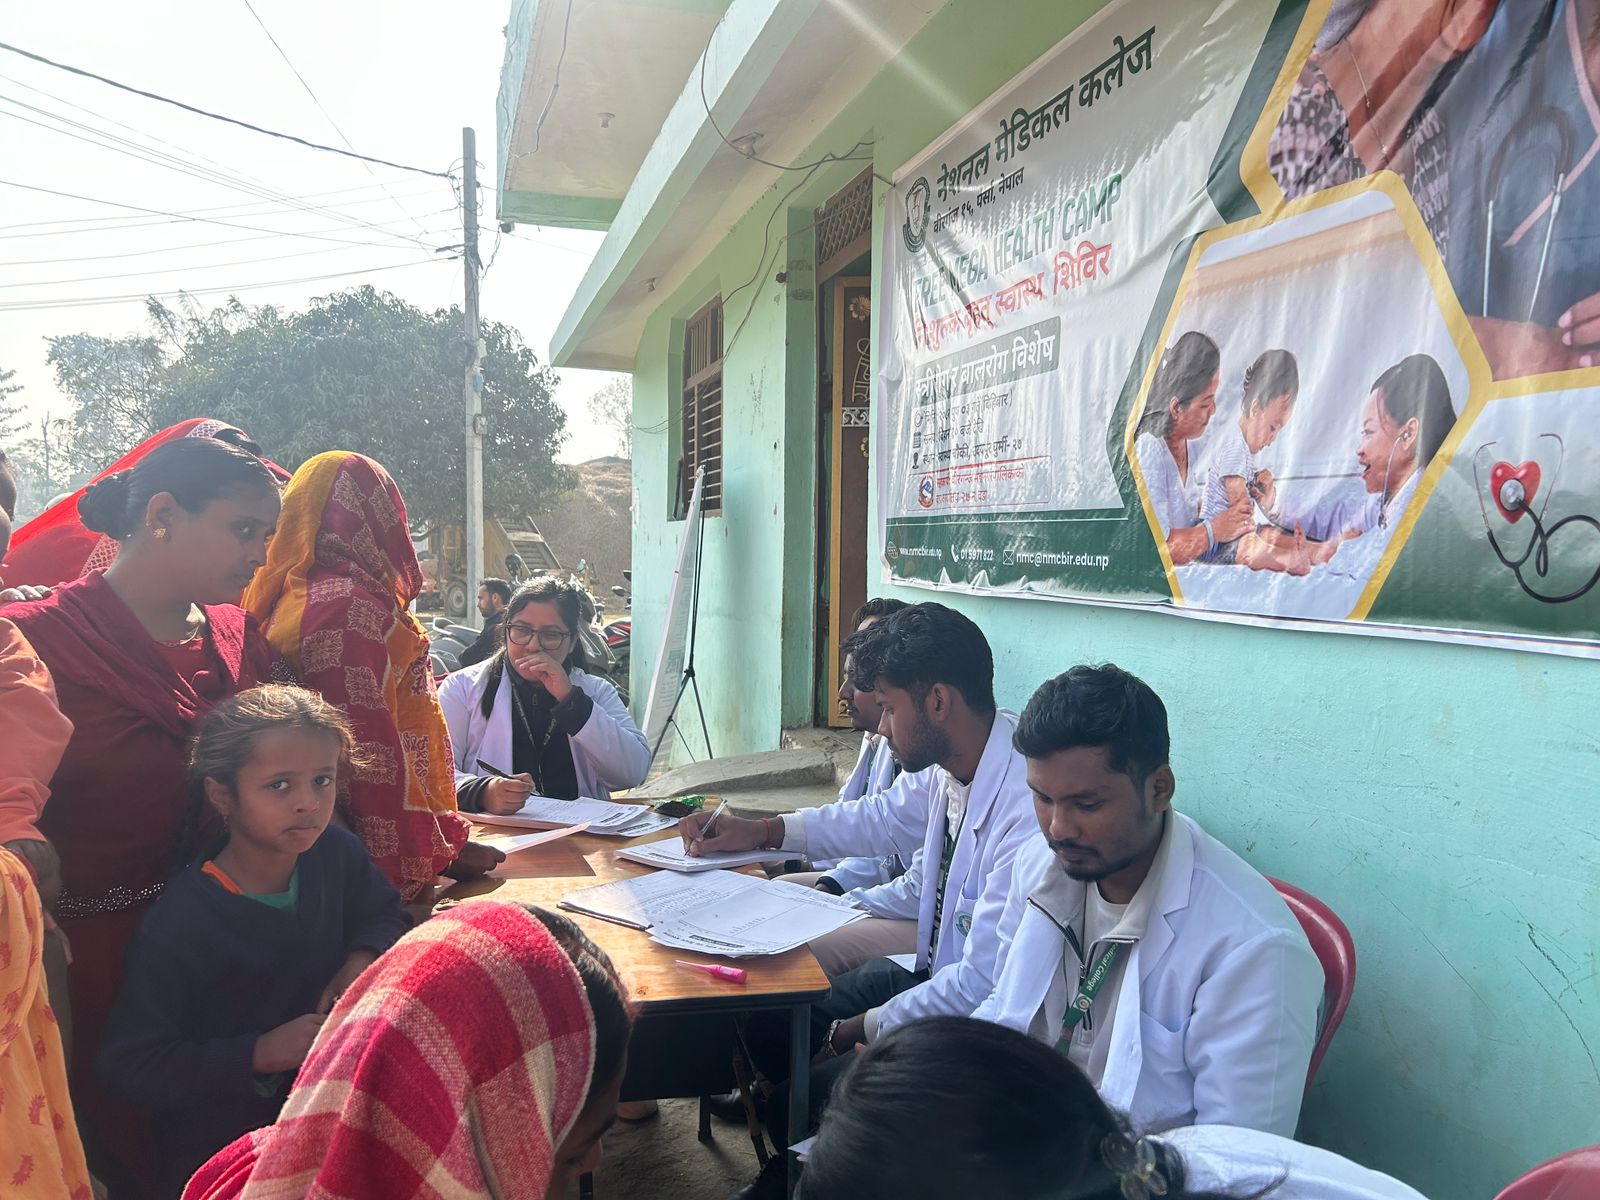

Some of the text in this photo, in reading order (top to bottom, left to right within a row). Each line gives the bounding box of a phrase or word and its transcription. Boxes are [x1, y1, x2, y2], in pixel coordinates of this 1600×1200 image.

[936, 26, 1157, 202] नेशनल मेडिकल कलेज
[933, 203, 960, 234] वीरगंज
[998, 166, 1025, 195] नेपाल
[914, 264, 947, 312] FREE
[949, 245, 989, 293] MEGA
[992, 206, 1056, 276] HEALTH
[1061, 173, 1123, 241] CAMP
[1053, 240, 1113, 296] शिविर
[960, 345, 1009, 385] बालरोग
[1011, 330, 1056, 373] विशेष
[1016, 551, 1109, 571] nmc@nmcbir.edu.np
[1086, 965, 1105, 992] College
